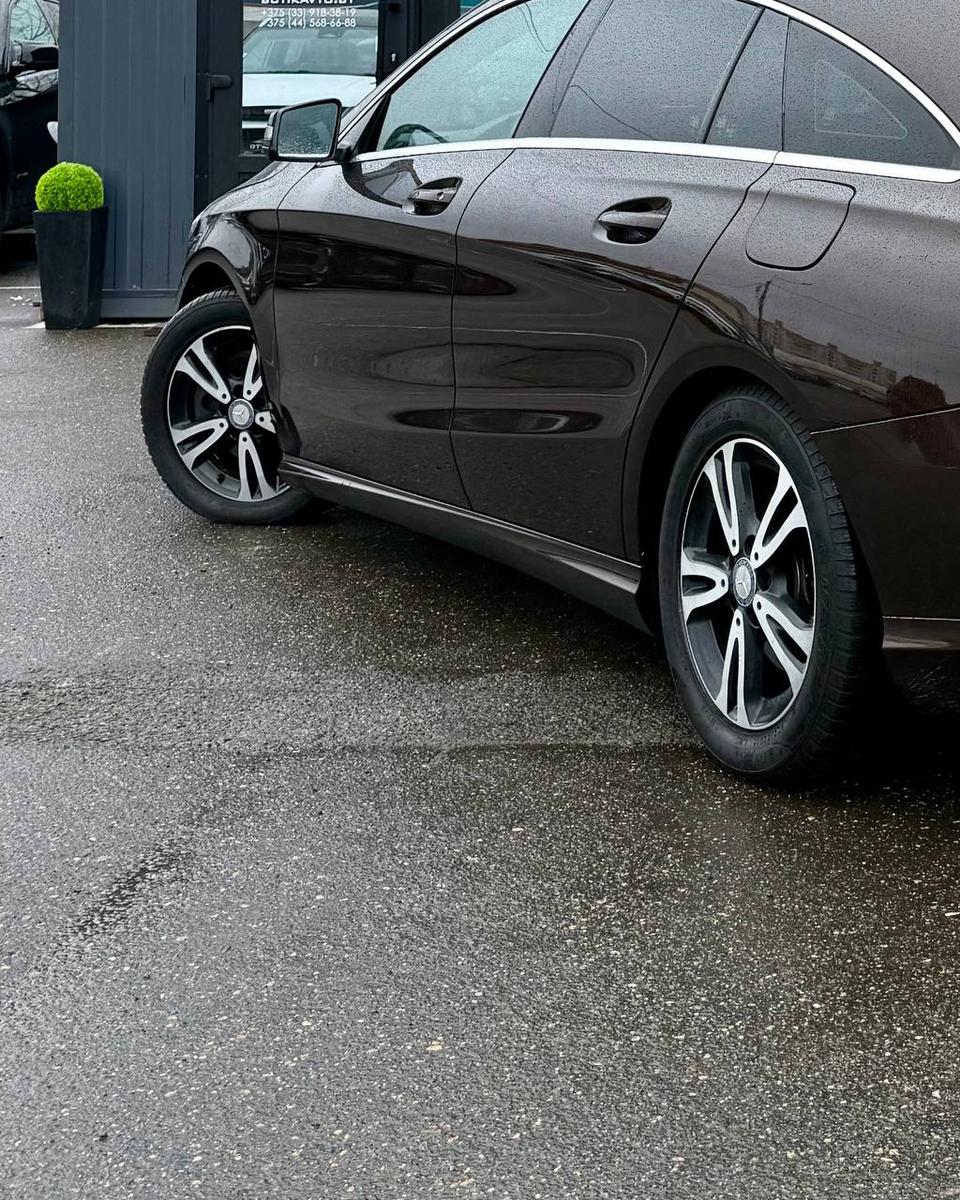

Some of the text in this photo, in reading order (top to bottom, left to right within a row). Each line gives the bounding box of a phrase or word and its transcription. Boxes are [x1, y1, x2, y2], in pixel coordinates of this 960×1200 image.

[262, 8, 356, 20] +375 (33) 918-38-19
[288, 19, 306, 29] (44)
[309, 19, 356, 28] 568-66-88
